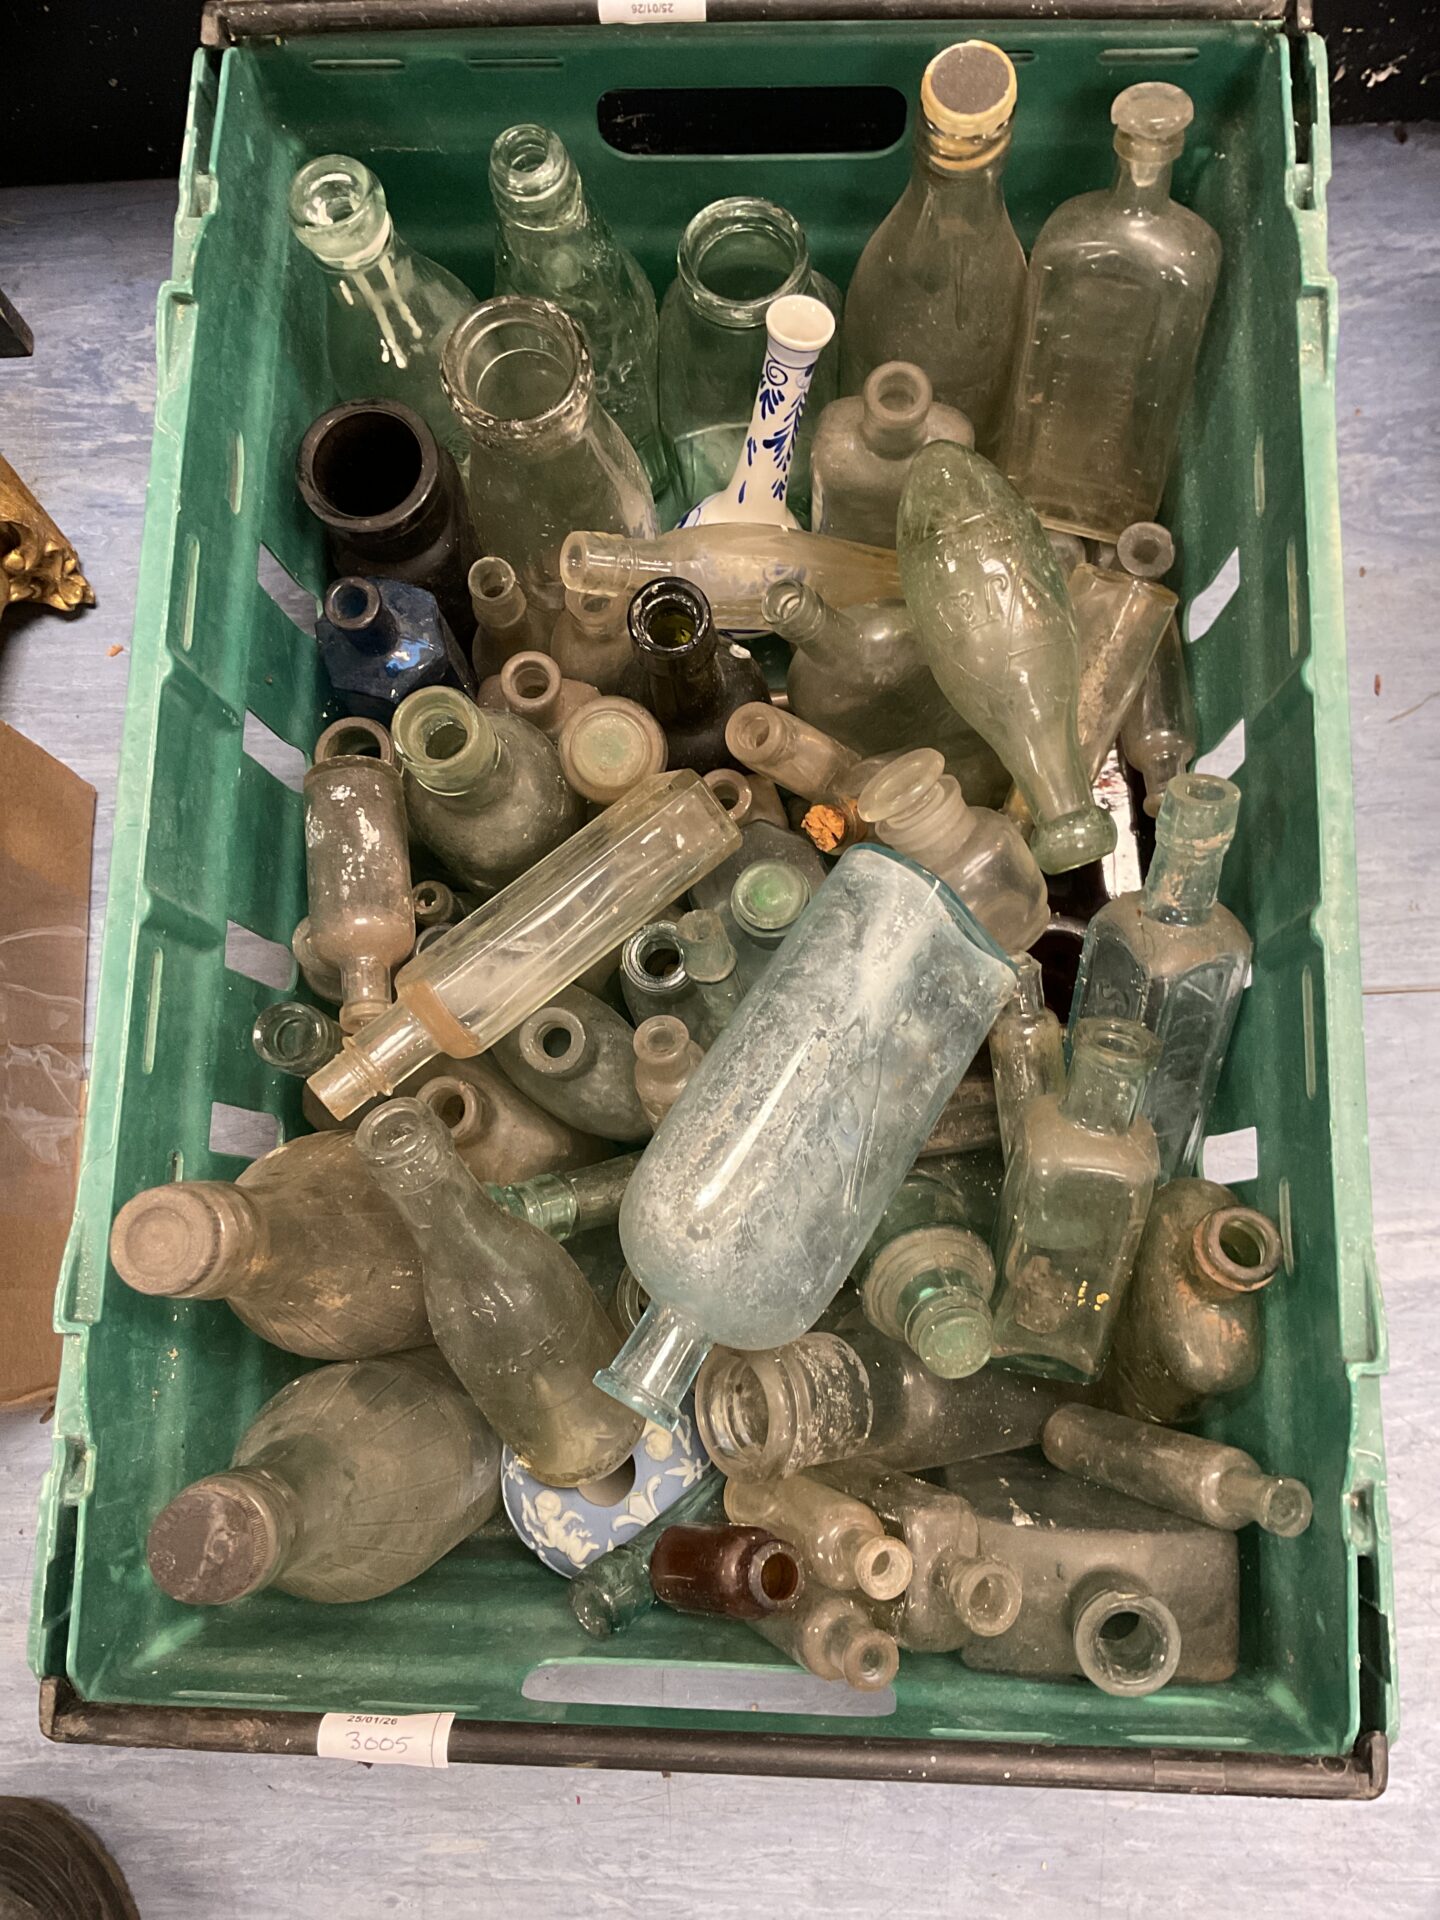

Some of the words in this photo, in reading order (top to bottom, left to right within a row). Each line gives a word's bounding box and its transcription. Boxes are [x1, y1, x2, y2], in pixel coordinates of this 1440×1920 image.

[631, 3, 674, 14] 25/01/26
[346, 1715, 399, 1726] 25/01/26
[345, 1731, 415, 1754] 3005
